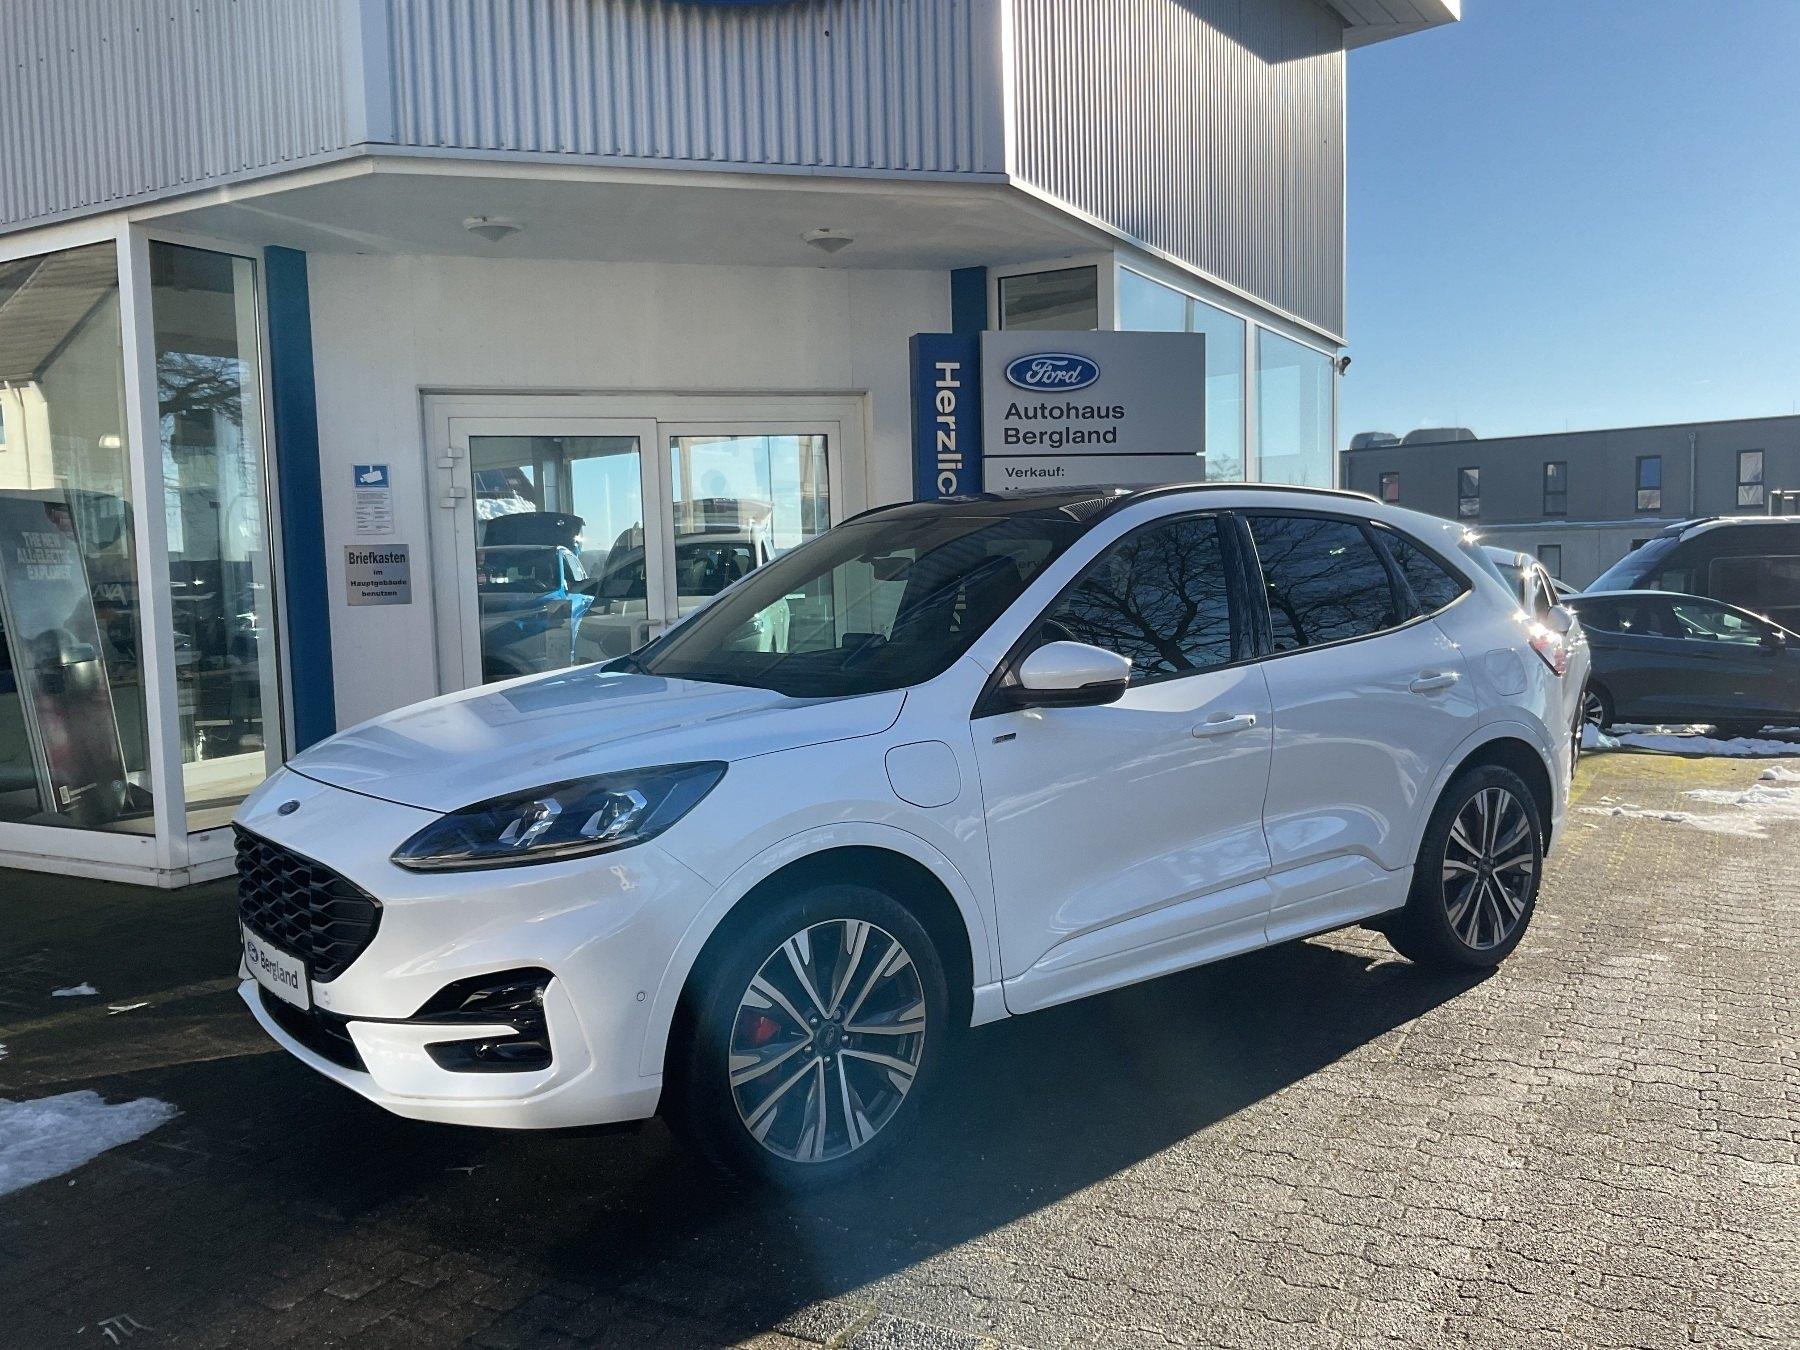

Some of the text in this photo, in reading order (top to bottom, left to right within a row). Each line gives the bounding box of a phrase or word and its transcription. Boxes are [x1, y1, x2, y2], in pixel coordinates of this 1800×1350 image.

[1025, 359, 1083, 384] Ford
[1004, 402, 1125, 420] Autohaus
[935, 362, 963, 500] Herzlic
[1004, 426, 1117, 449] Bergland
[1005, 467, 1065, 478] Verkauf:
[348, 552, 406, 564] Briefkasten
[260, 950, 299, 990] Bergland
